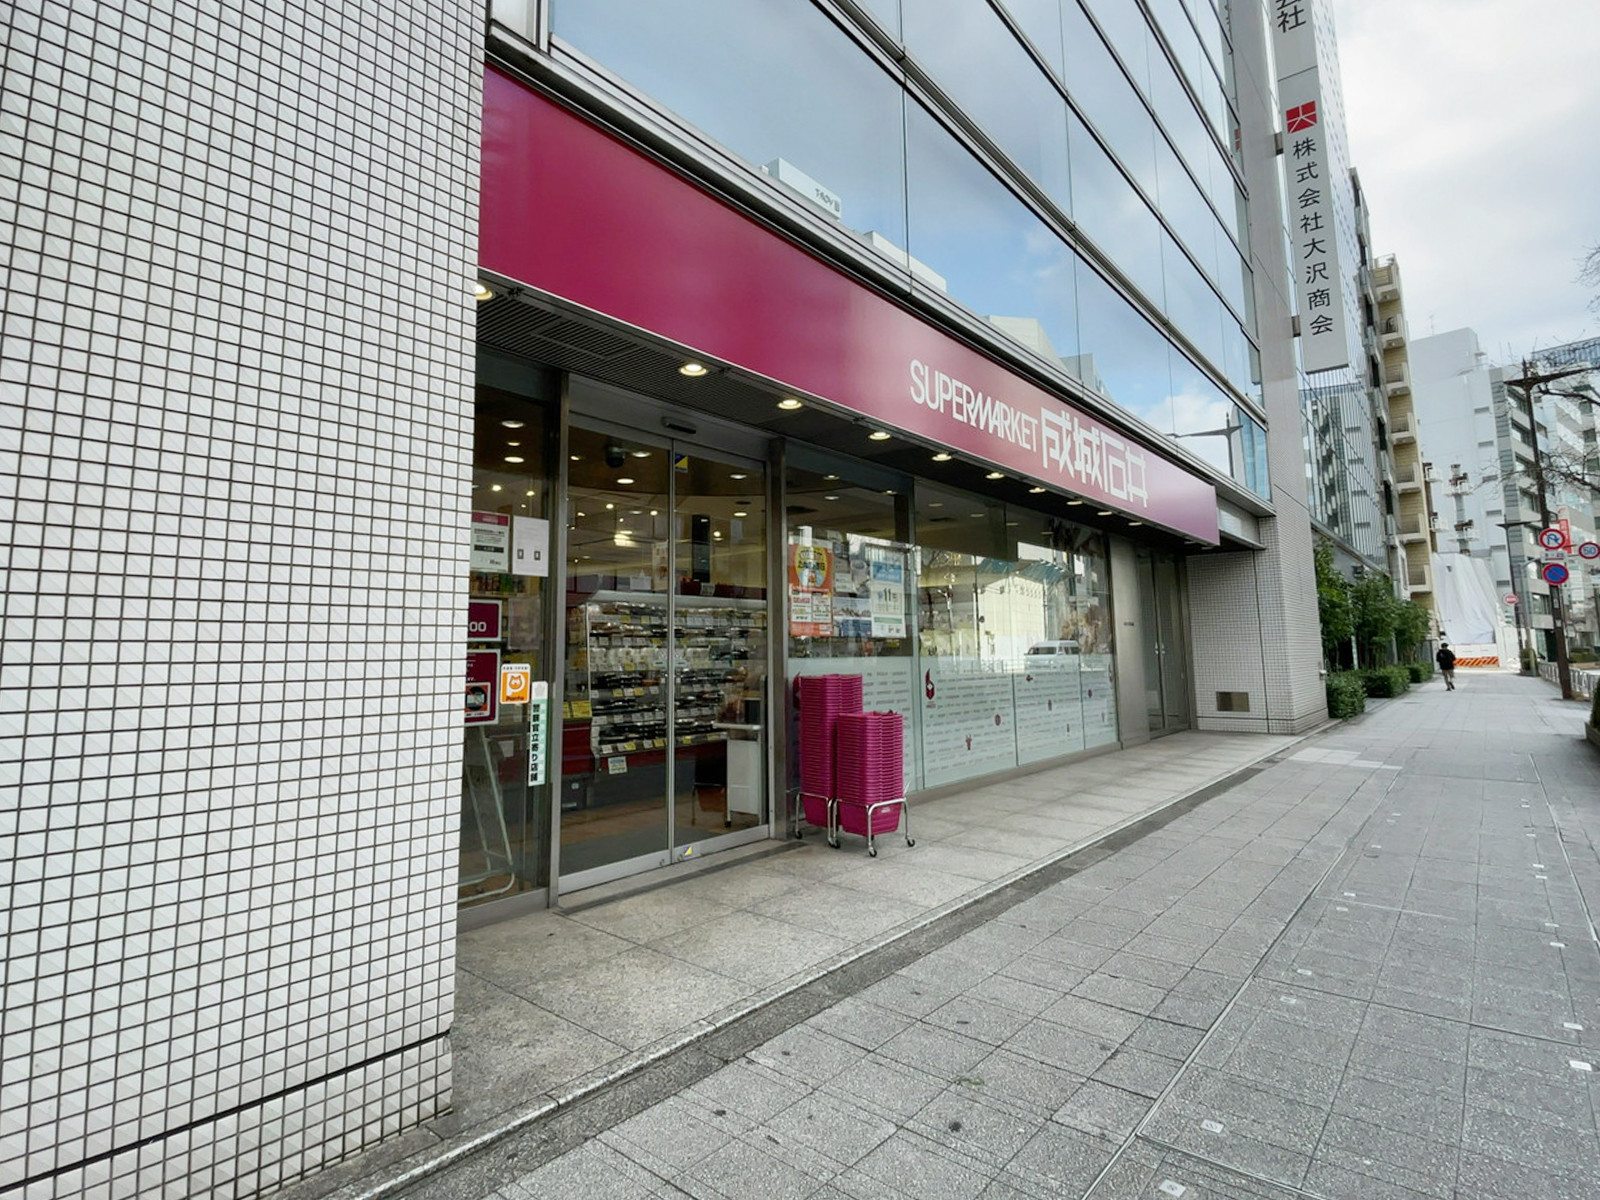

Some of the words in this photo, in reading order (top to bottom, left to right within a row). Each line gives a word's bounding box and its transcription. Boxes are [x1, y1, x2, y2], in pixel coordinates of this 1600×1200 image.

[1293, 136, 1334, 336] 株式会社大沢商会
[909, 358, 1038, 453] SUPERMARKET
[1040, 406, 1149, 508] 成城石井
[1583, 546, 1596, 555] 50
